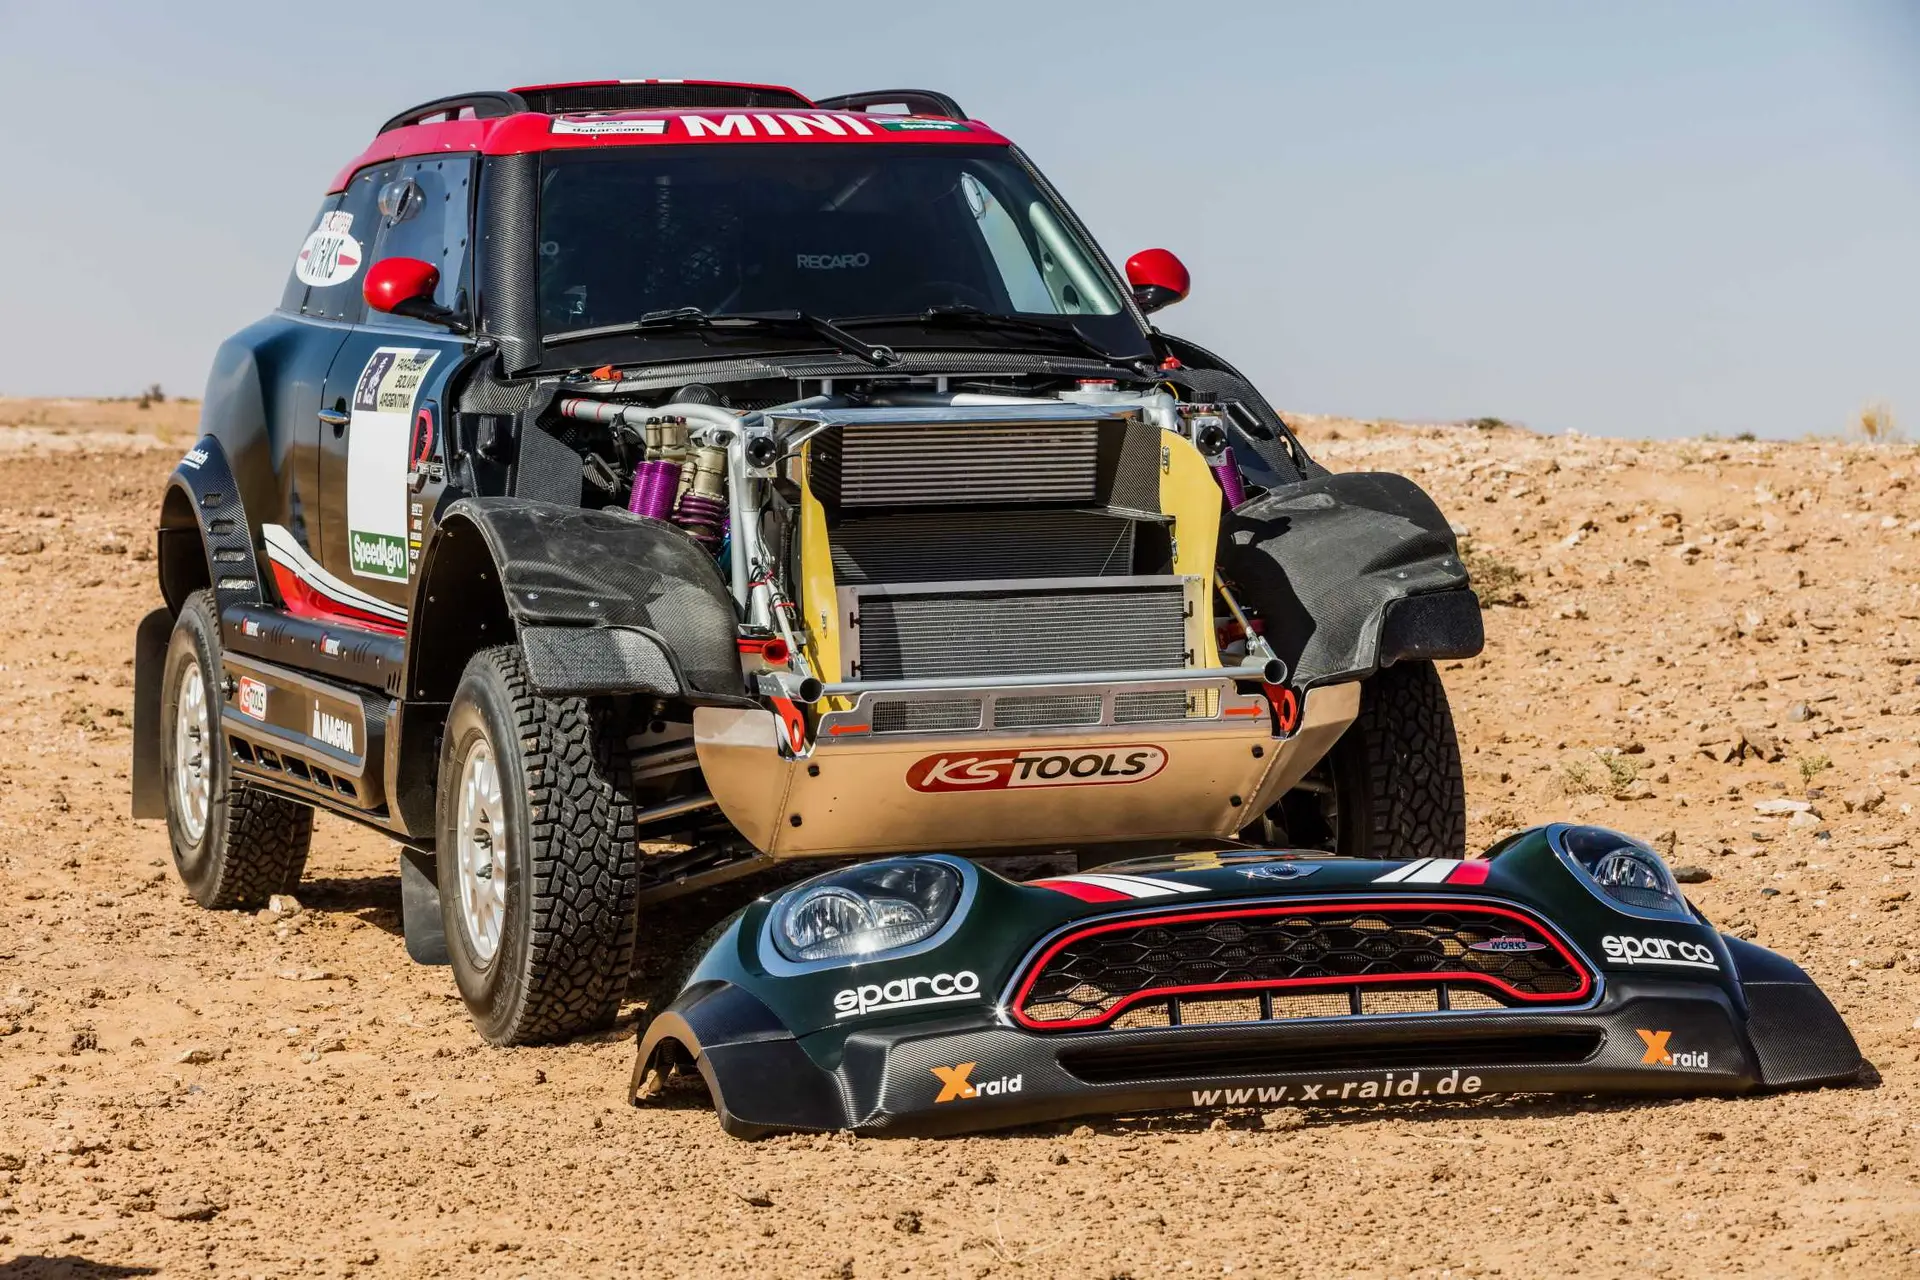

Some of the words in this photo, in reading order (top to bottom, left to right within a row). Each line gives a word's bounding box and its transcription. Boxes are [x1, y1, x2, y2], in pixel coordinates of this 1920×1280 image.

[679, 115, 874, 137] MINI
[303, 236, 345, 279] WORKS
[797, 252, 870, 270] RECARO
[394, 374, 420, 389] BOLIVIA
[378, 392, 412, 409] ARGENTINA
[353, 534, 404, 574] SpeedAgro
[321, 711, 354, 754] MAGNA
[921, 756, 1015, 787] KS
[1012, 752, 1149, 780] TOOLS
[1489, 941, 1528, 950] WORKS
[1601, 935, 1716, 966] sparco
[834, 971, 980, 1016] sparco
[1635, 1029, 1709, 1068] X-raid
[929, 1061, 1023, 1104] X-raid
[1191, 1069, 1483, 1108] www.x-raid.de
